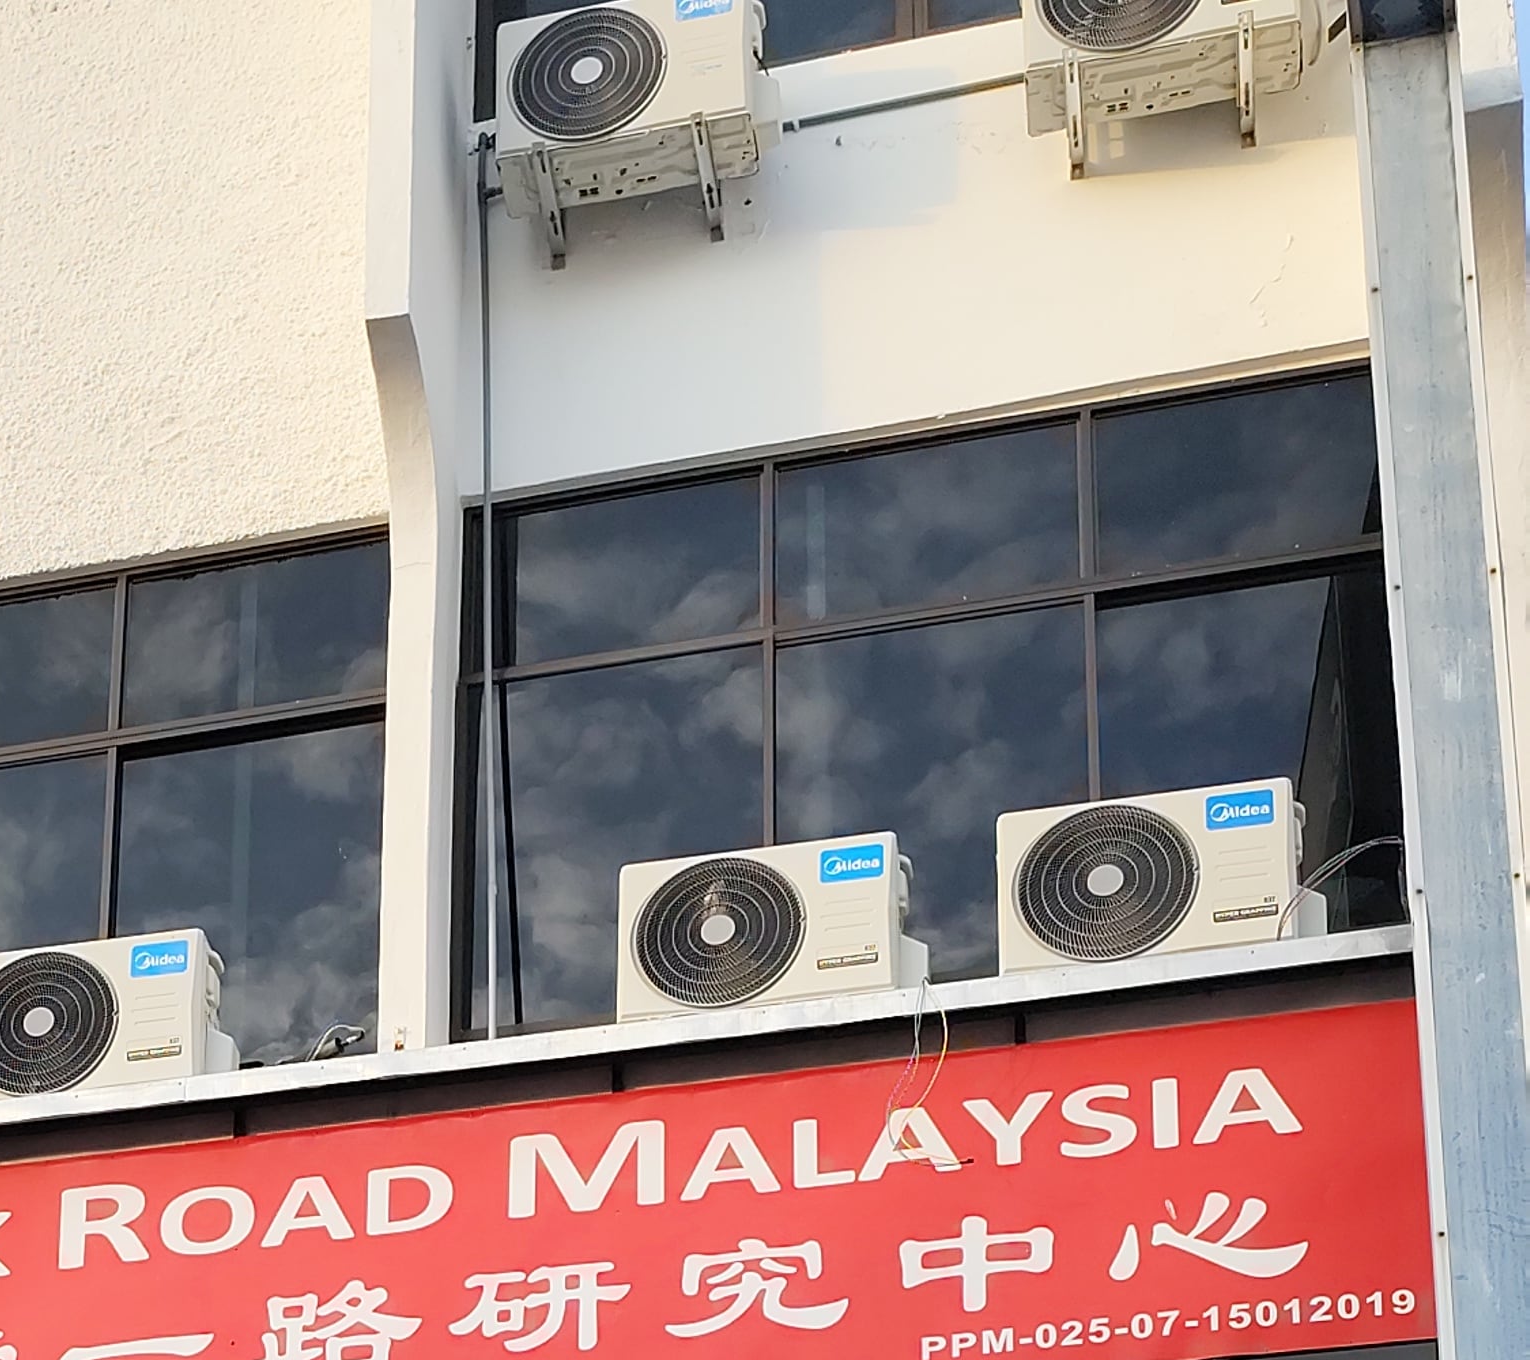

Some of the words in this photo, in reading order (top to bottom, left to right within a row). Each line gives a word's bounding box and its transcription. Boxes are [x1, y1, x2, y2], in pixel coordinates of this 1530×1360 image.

[1210, 803, 1270, 822] Midea
[824, 856, 880, 875] Midea
[134, 952, 185, 970] Midea
[58, 1165, 454, 1270] ROAD
[508, 1068, 1303, 1219] MALAYSIA
